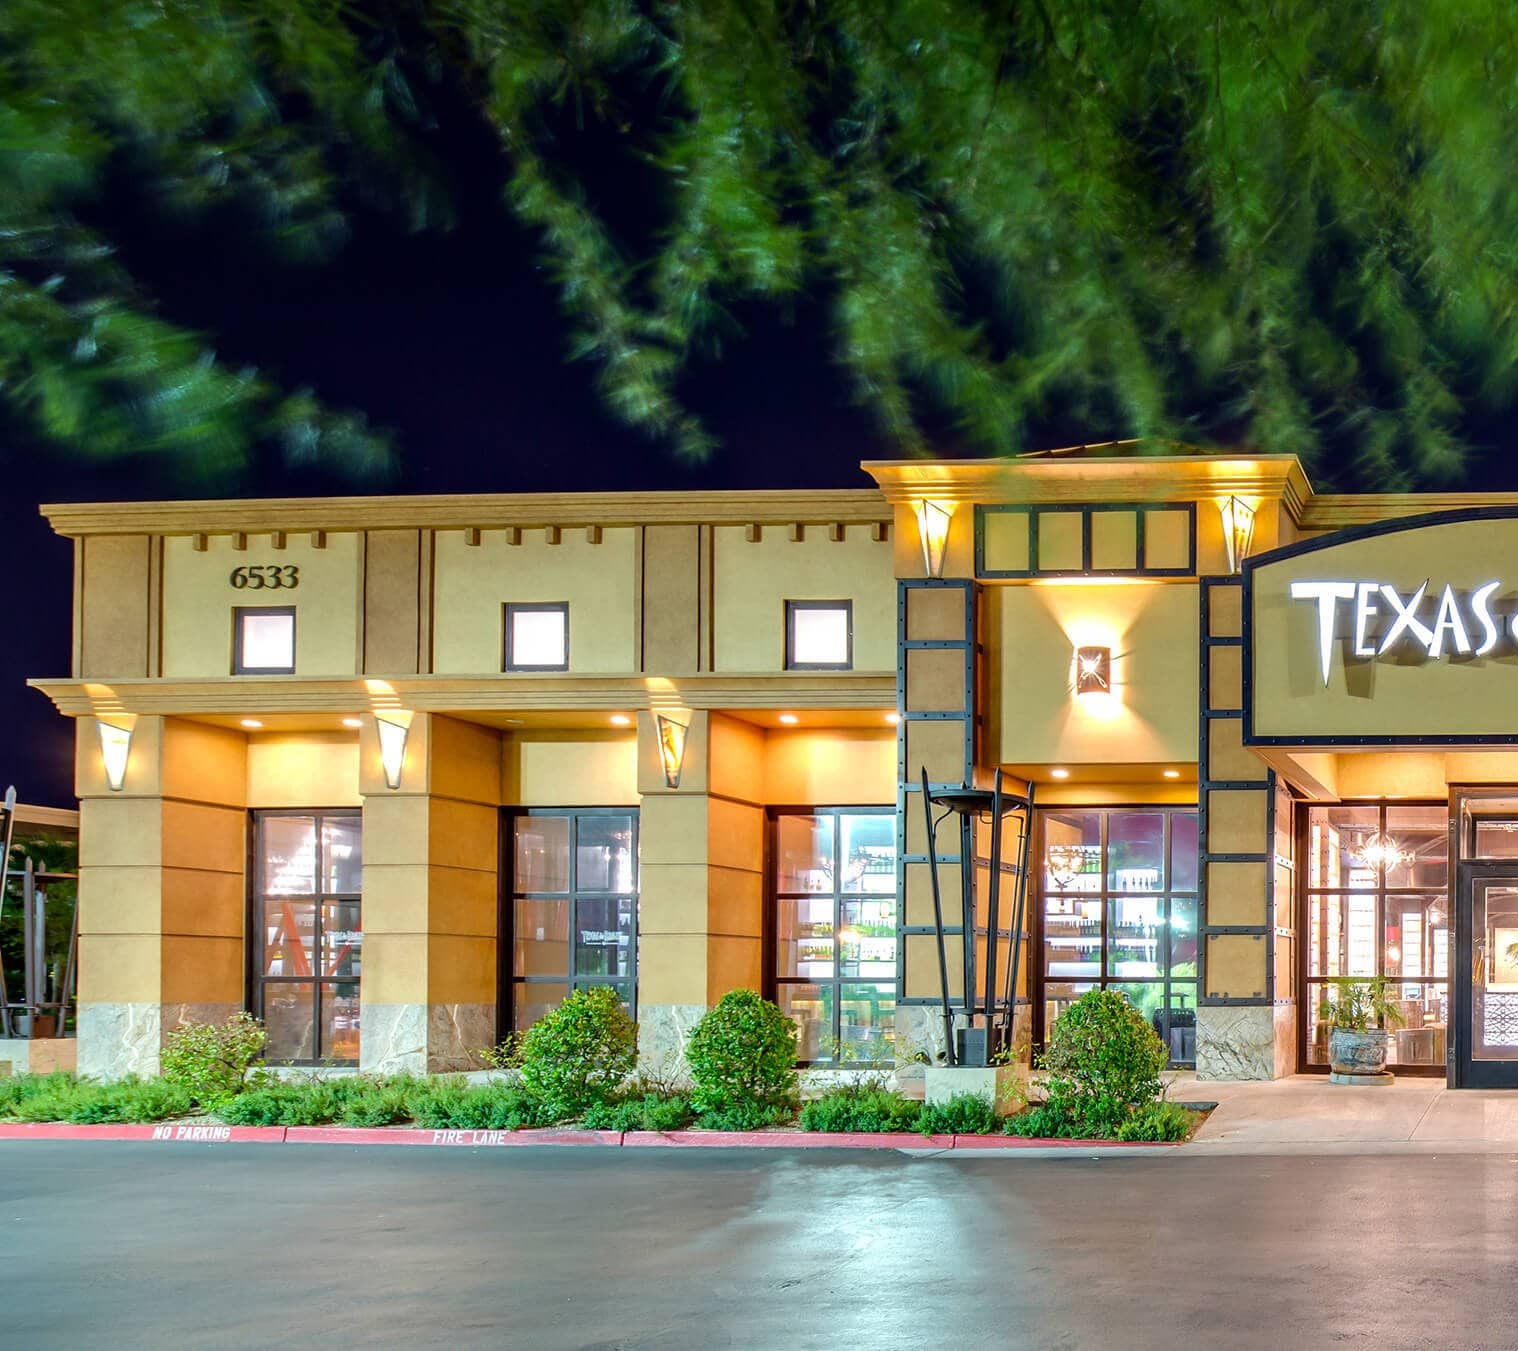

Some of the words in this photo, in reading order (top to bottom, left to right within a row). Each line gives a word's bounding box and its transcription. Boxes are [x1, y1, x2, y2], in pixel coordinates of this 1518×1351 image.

[229, 565, 299, 590] 6533
[1290, 578, 1501, 687] TEXAS
[152, 1126, 172, 1140] NO
[175, 1126, 231, 1140] PARKING
[432, 1130, 465, 1144] FIRE
[472, 1130, 508, 1145] LANE
